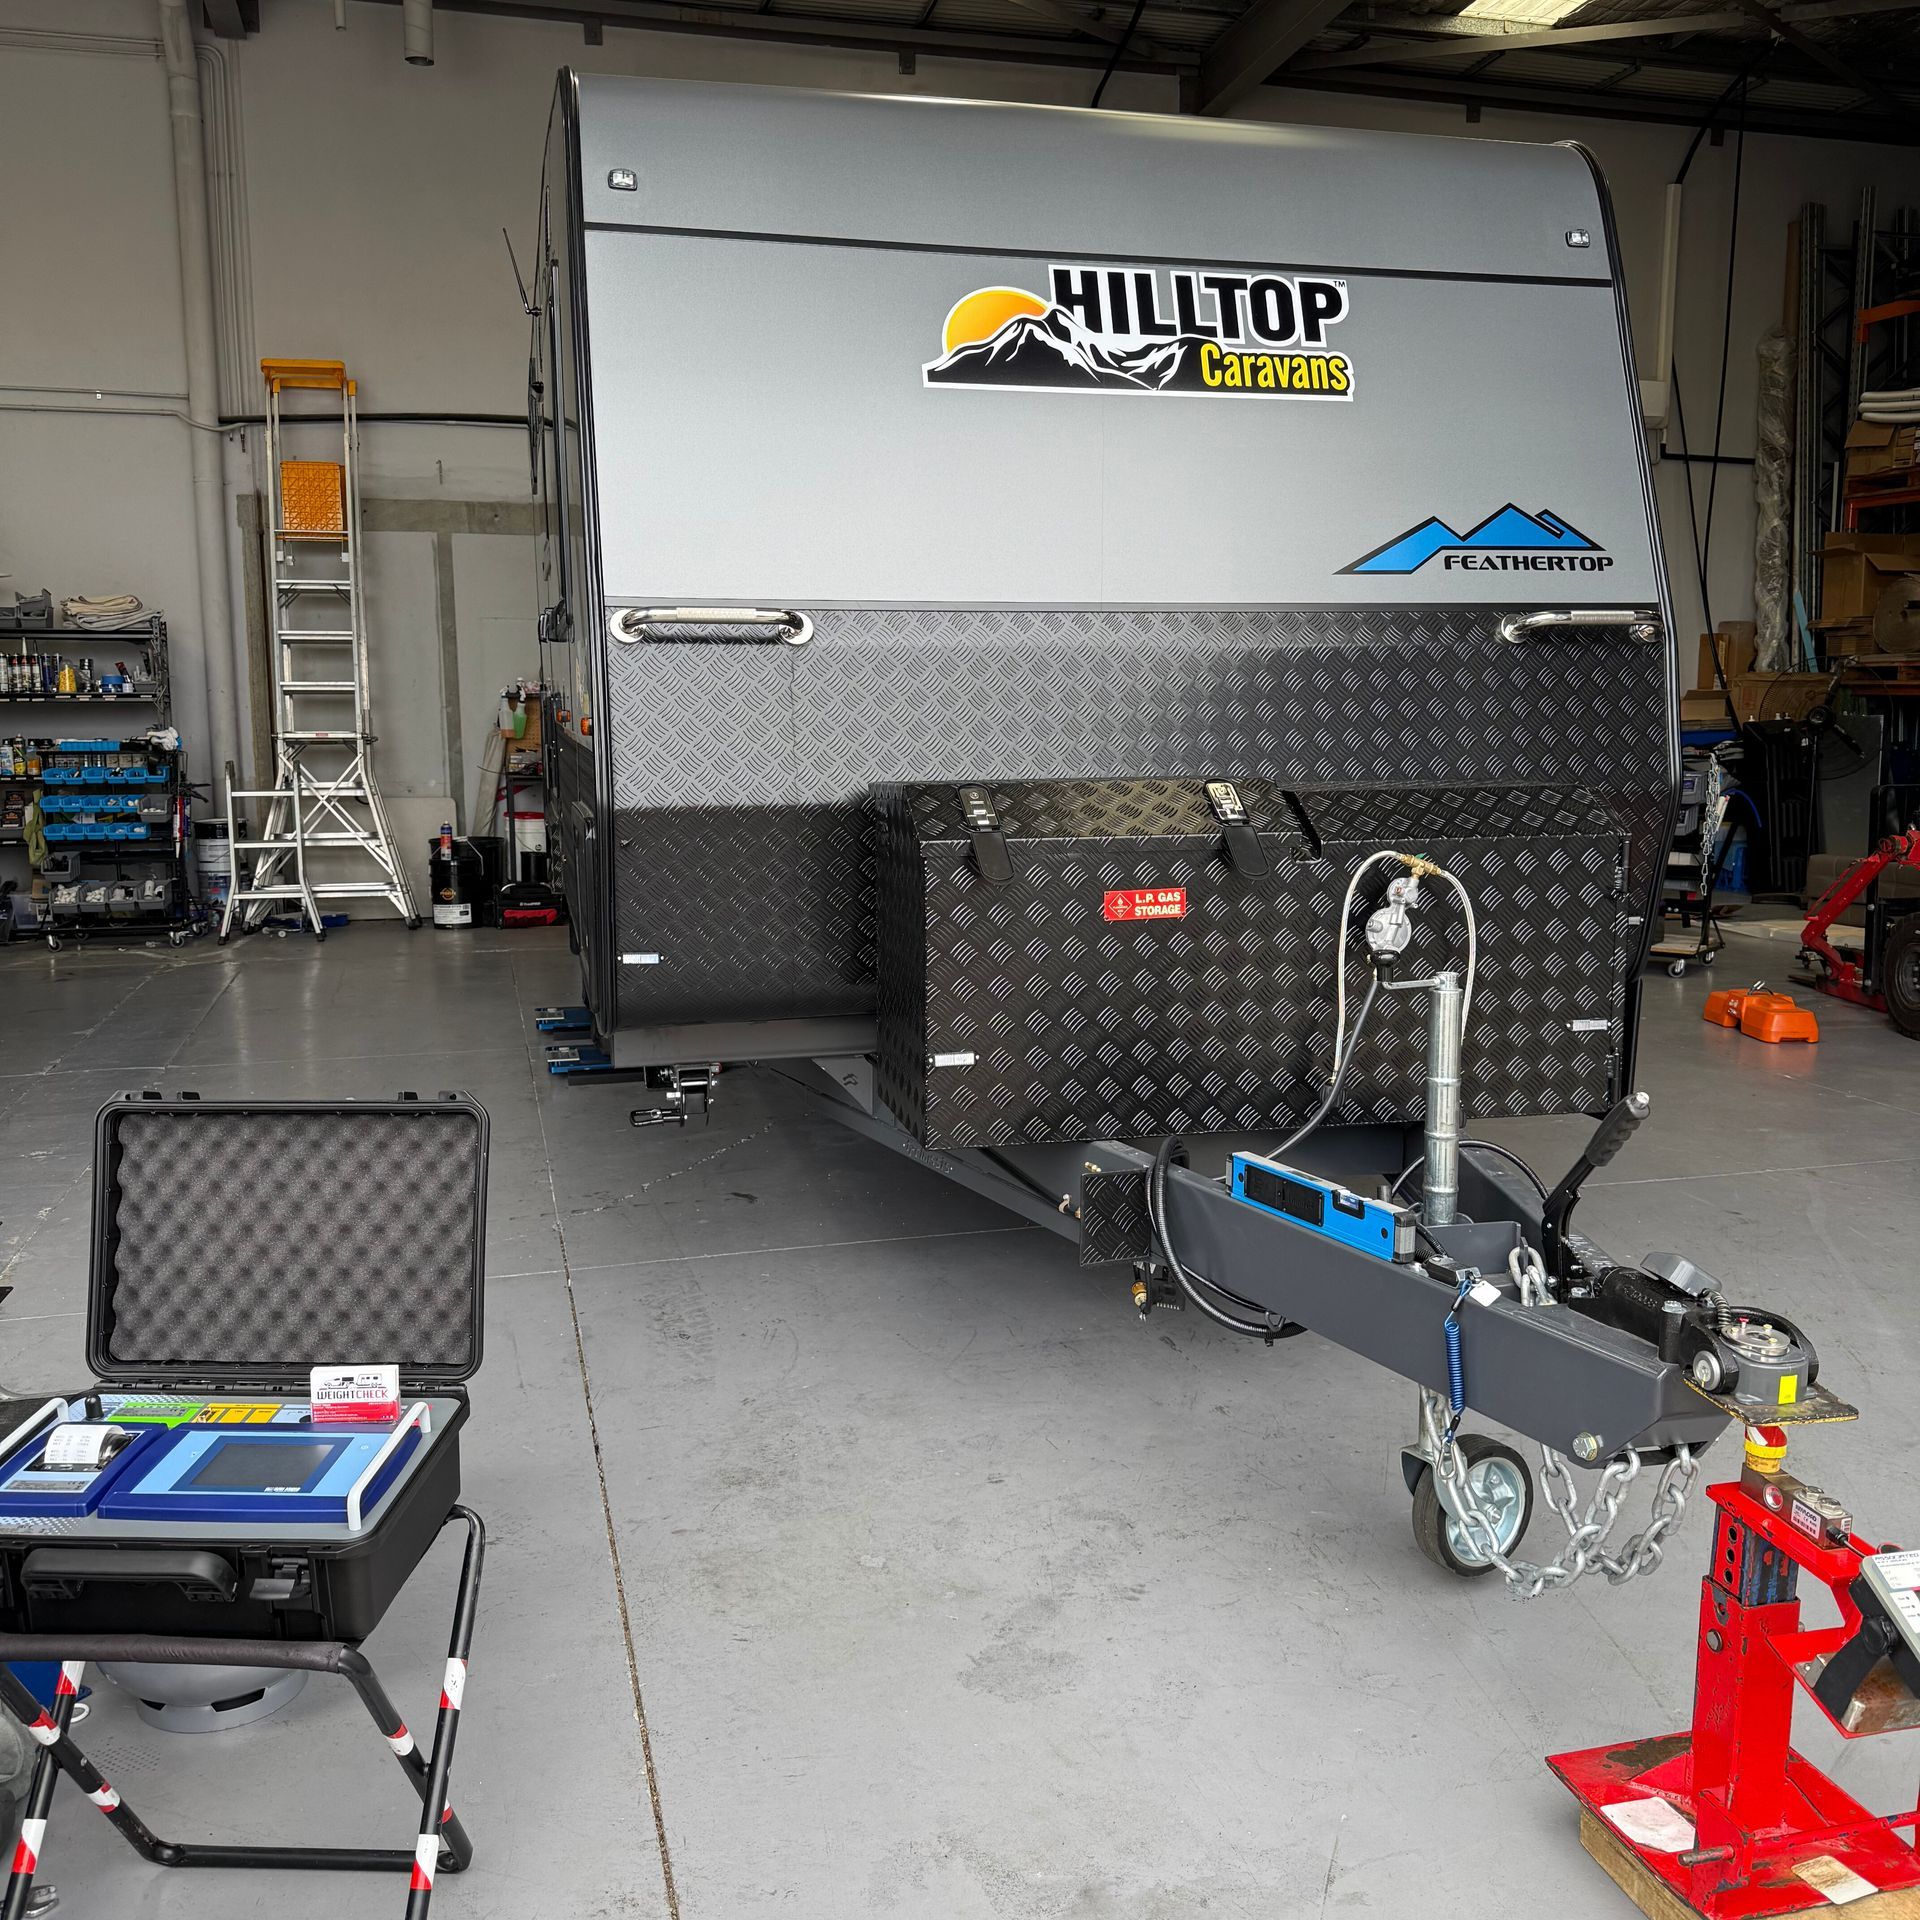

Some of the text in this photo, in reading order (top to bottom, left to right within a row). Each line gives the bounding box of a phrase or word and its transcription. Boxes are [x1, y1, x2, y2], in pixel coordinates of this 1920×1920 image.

[1053, 268, 1342, 343] HILLTOP
[1199, 342, 1348, 392] Caravans
[1444, 555, 1614, 571] FEATHERTOP
[1157, 891, 1181, 902] GAS
[1134, 904, 1181, 916] STORAGE
[316, 1389, 389, 1400] WEIGHTCHECK
